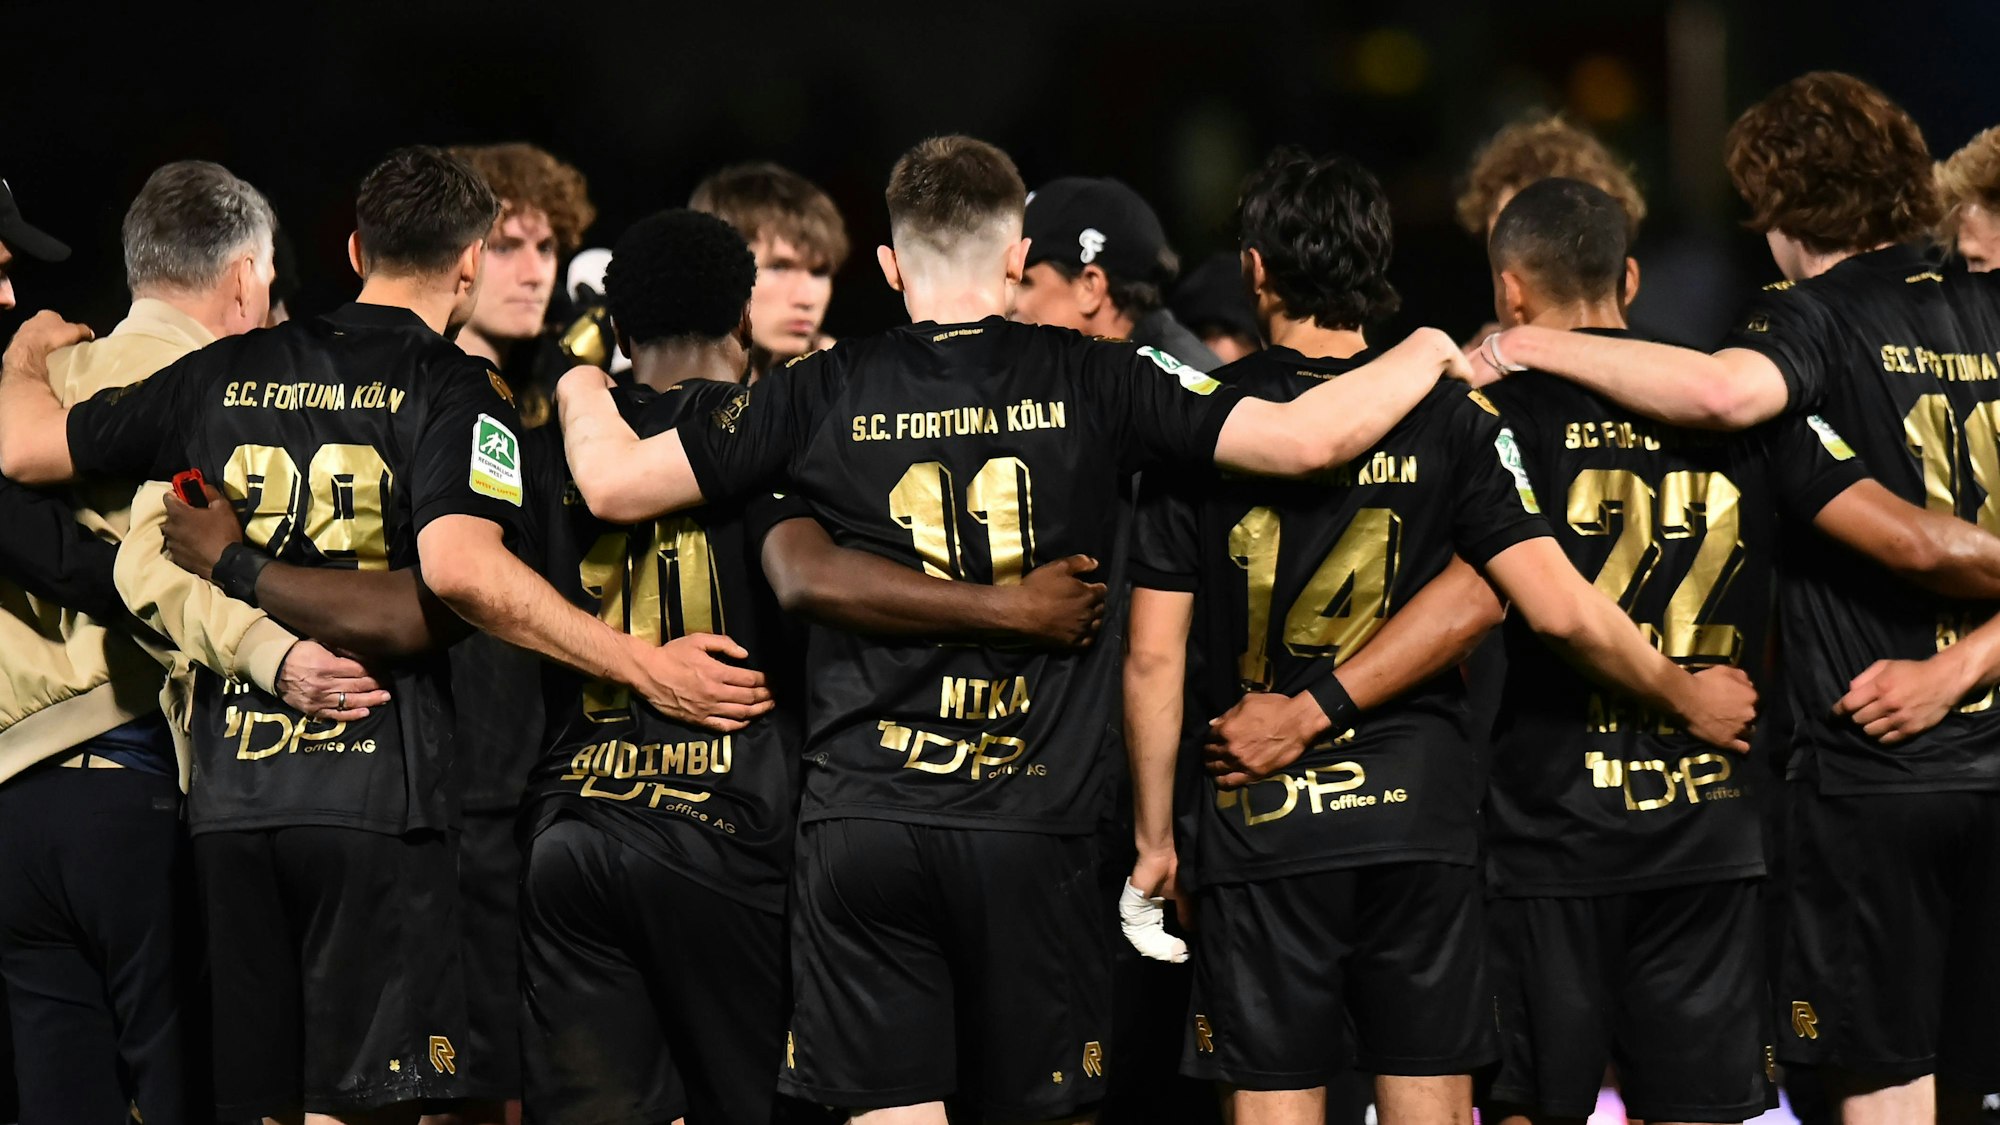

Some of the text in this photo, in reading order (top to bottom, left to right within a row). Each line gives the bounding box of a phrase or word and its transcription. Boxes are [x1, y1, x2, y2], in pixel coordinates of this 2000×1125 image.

[223, 381, 405, 414] S.C. FORTUNA KÖLN
[852, 398, 1066, 442] S.C. FORTUNA KÖLN
[1358, 452, 1418, 486] KÖLN
[223, 443, 394, 571] 29
[888, 456, 1036, 586] 11
[1567, 469, 1745, 668] 22
[1228, 506, 1402, 692] 14
[939, 675, 1031, 720] MIKA
[351, 738, 377, 754] AG
[571, 735, 732, 779] BUDIMBU
[1026, 763, 1047, 777] AG
[665, 802, 736, 834] office AG
[1329, 788, 1408, 811] office AG
